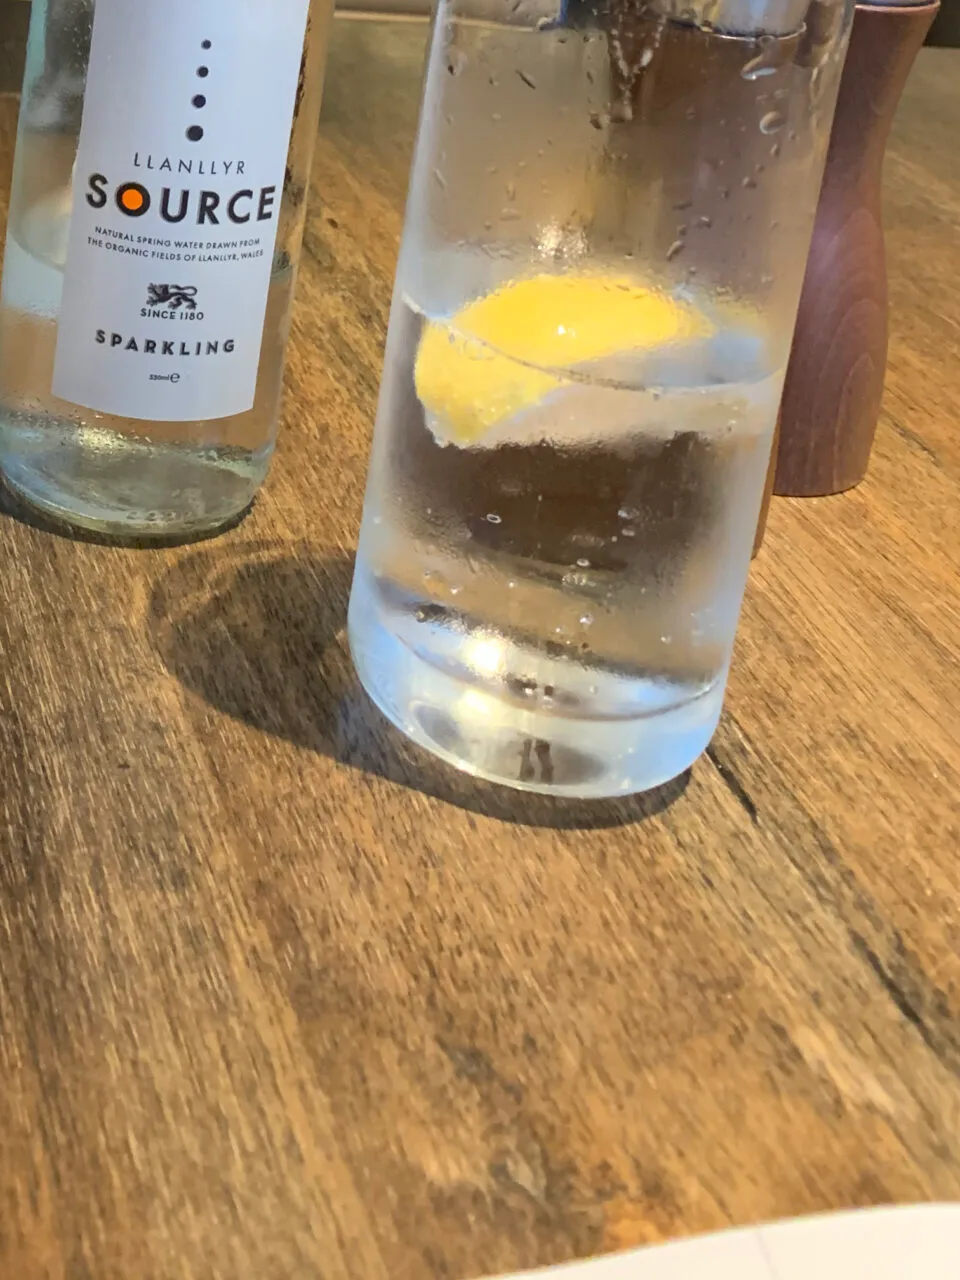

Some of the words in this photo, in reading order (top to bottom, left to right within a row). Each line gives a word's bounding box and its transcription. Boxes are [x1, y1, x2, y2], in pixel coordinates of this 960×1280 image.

[133, 152, 246, 175] LLANLLYR
[85, 173, 277, 226] SOURCE
[87, 236, 103, 248] THE
[105, 242, 149, 258] ORGANIC
[151, 251, 181, 261] FIELDS
[184, 254, 196, 262] OF
[241, 249, 264, 260] WALES
[95, 226, 134, 242] NATURAL
[137, 236, 171, 247] SPRING
[174, 240, 204, 249] WATER
[206, 241, 238, 249] DRAWN
[239, 238, 260, 248] FROM
[140, 307, 176, 320] SINCE
[180, 311, 204, 321] 1180
[95, 329, 236, 356] SPARKLING
